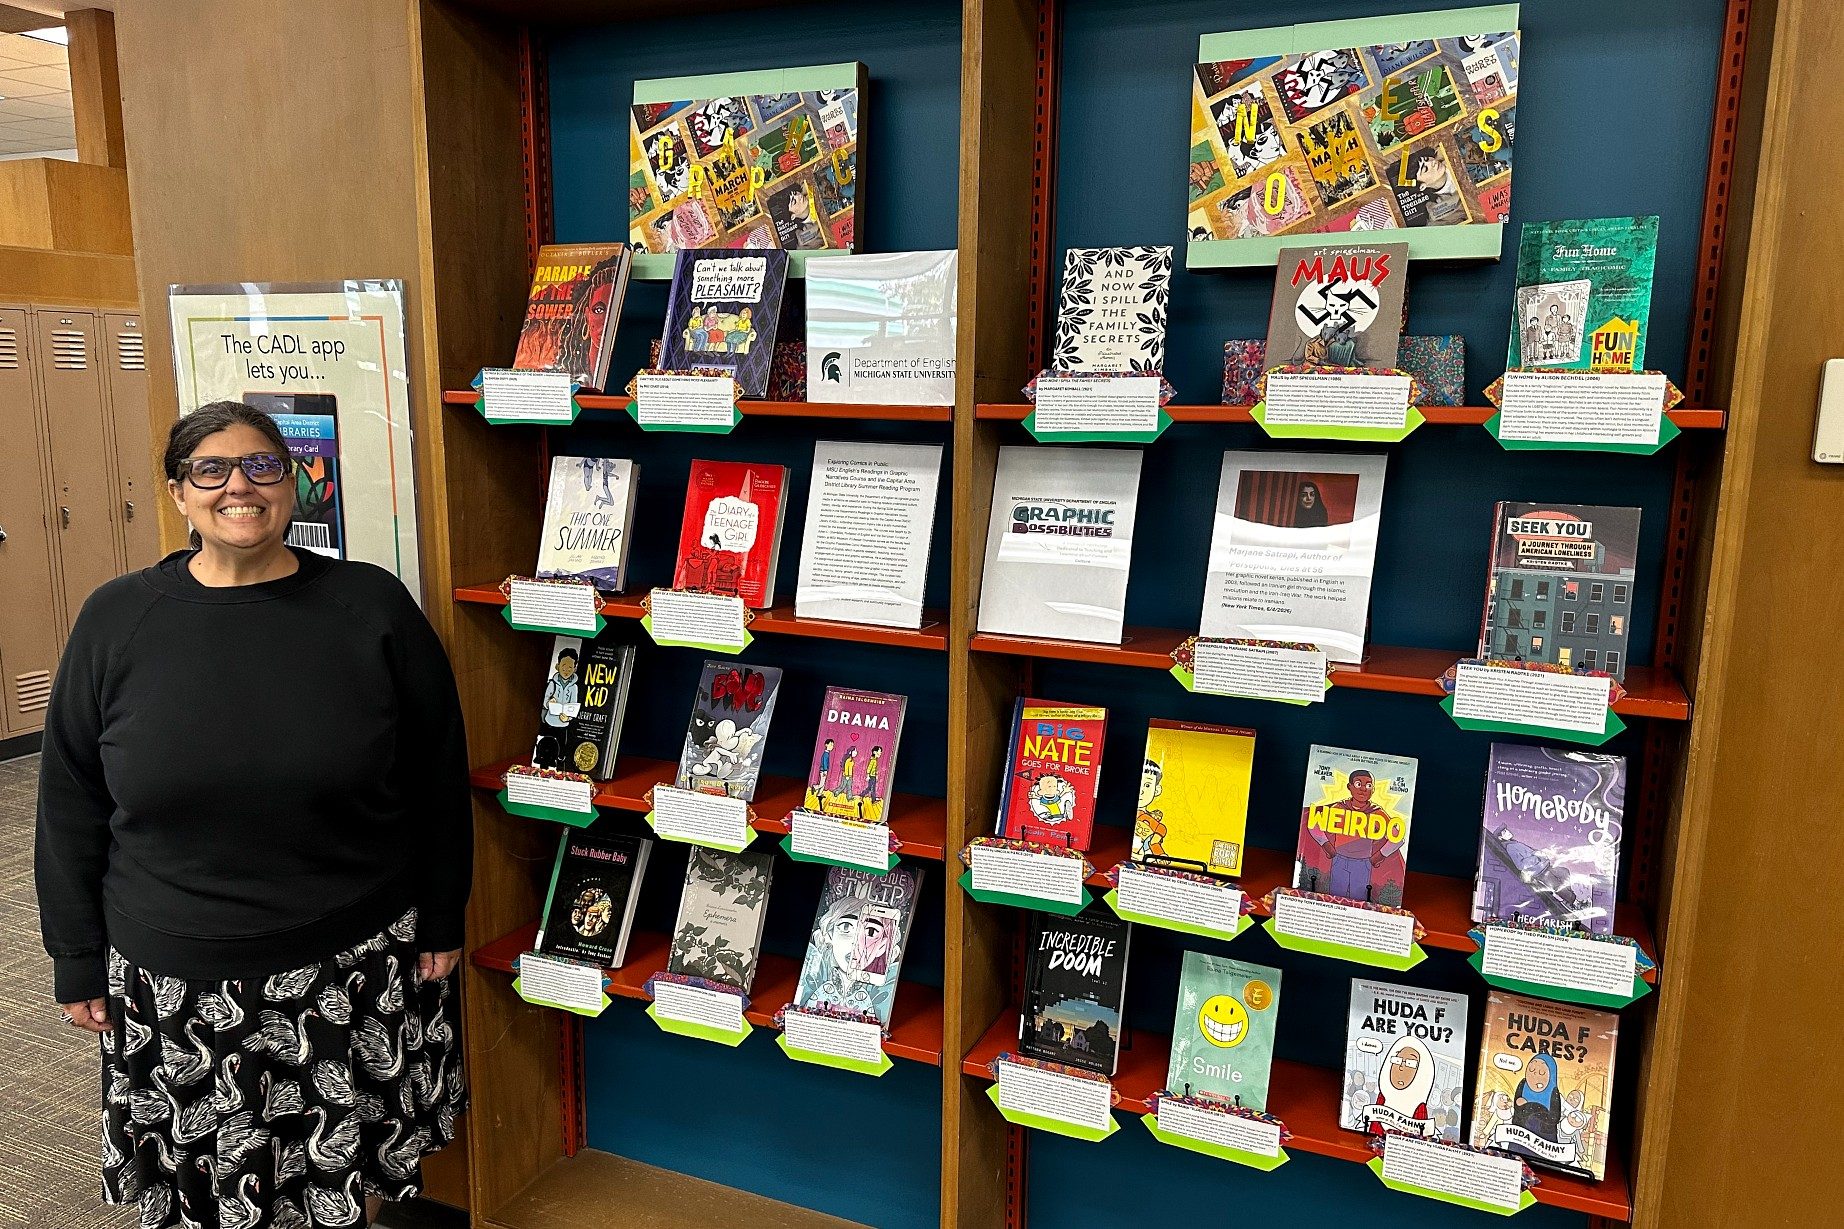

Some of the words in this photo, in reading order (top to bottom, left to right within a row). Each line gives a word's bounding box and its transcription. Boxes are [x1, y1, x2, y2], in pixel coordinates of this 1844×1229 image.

[1406, 46, 1433, 63] WILSON
[1465, 54, 1496, 71] GHOST
[1467, 58, 1497, 75] WORLD
[715, 172, 748, 197] MARCH
[1397, 191, 1409, 200] The
[1553, 245, 1579, 260] Fun
[1580, 244, 1617, 259] Home
[535, 265, 591, 281] PARABLE
[696, 263, 716, 273] Can't
[730, 263, 743, 272] talk
[745, 263, 764, 272] about
[1105, 270, 1134, 278] AND
[1291, 254, 1391, 287] MAUS
[697, 274, 733, 284] something
[1101, 283, 1135, 291] NOW
[550, 284, 574, 300] THE
[695, 283, 760, 298] PLEASANT?
[1103, 296, 1139, 304] SPILL
[527, 303, 573, 320] SOWER
[1101, 309, 1127, 317] THE
[1089, 322, 1137, 331] FAMILY
[1083, 335, 1140, 343] SECRETS
[1594, 332, 1633, 351] FUN
[221, 334, 252, 354] The
[257, 334, 306, 354] CADL
[312, 340, 345, 361] app
[854, 358, 908, 369] Department
[910, 357, 920, 368] of
[923, 358, 956, 369] English
[1593, 352, 1631, 364] HOME
[246, 359, 274, 379] lets
[280, 365, 325, 384] you...
[914, 371, 957, 379] UNIVERSITY
[279, 426, 320, 437] IBRARIES
[304, 444, 319, 452] Card
[718, 503, 750, 516] DIARY
[1013, 506, 1115, 526] GRAPHIC
[570, 512, 591, 526] THIS
[591, 512, 613, 526] ONE
[709, 514, 754, 529] TEENAGE
[1510, 521, 1550, 534] SEEK
[1555, 523, 1587, 536] YOU
[554, 526, 622, 553] SUMMER
[1528, 541, 1559, 549] JOURNEY
[1300, 552, 1331, 560] Author
[1521, 548, 1552, 556] AMERICAN
[585, 664, 617, 685] NEW
[827, 709, 889, 730] DRAMA
[1023, 735, 1094, 766] NATE
[1022, 759, 1042, 768] GOES
[1046, 762, 1061, 771] FOR
[1065, 765, 1090, 776] BROKE
[1307, 803, 1406, 844] WEIRDO
[570, 845, 589, 857] Stuck
[589, 848, 612, 861] Rubber
[612, 852, 627, 864] Baby
[702, 909, 737, 924] Ephemera
[1540, 918, 1573, 930] PARISH
[1039, 931, 1117, 957] INCREDIBLE
[1048, 951, 1102, 978] DOOM
[1373, 998, 1428, 1021] HUDA
[1434, 1007, 1446, 1023] F
[1361, 1015, 1397, 1034] ARE
[1404, 1020, 1453, 1043] YOU?
[1508, 1012, 1569, 1041] HUDA
[1577, 1026, 1591, 1043] F
[1506, 1032, 1588, 1063] CARES?
[1192, 1056, 1243, 1083] Smile
[1372, 1107, 1395, 1120] HUDA
[1506, 1127, 1530, 1142] HUDA
[1534, 1138, 1565, 1154] FAHMY
